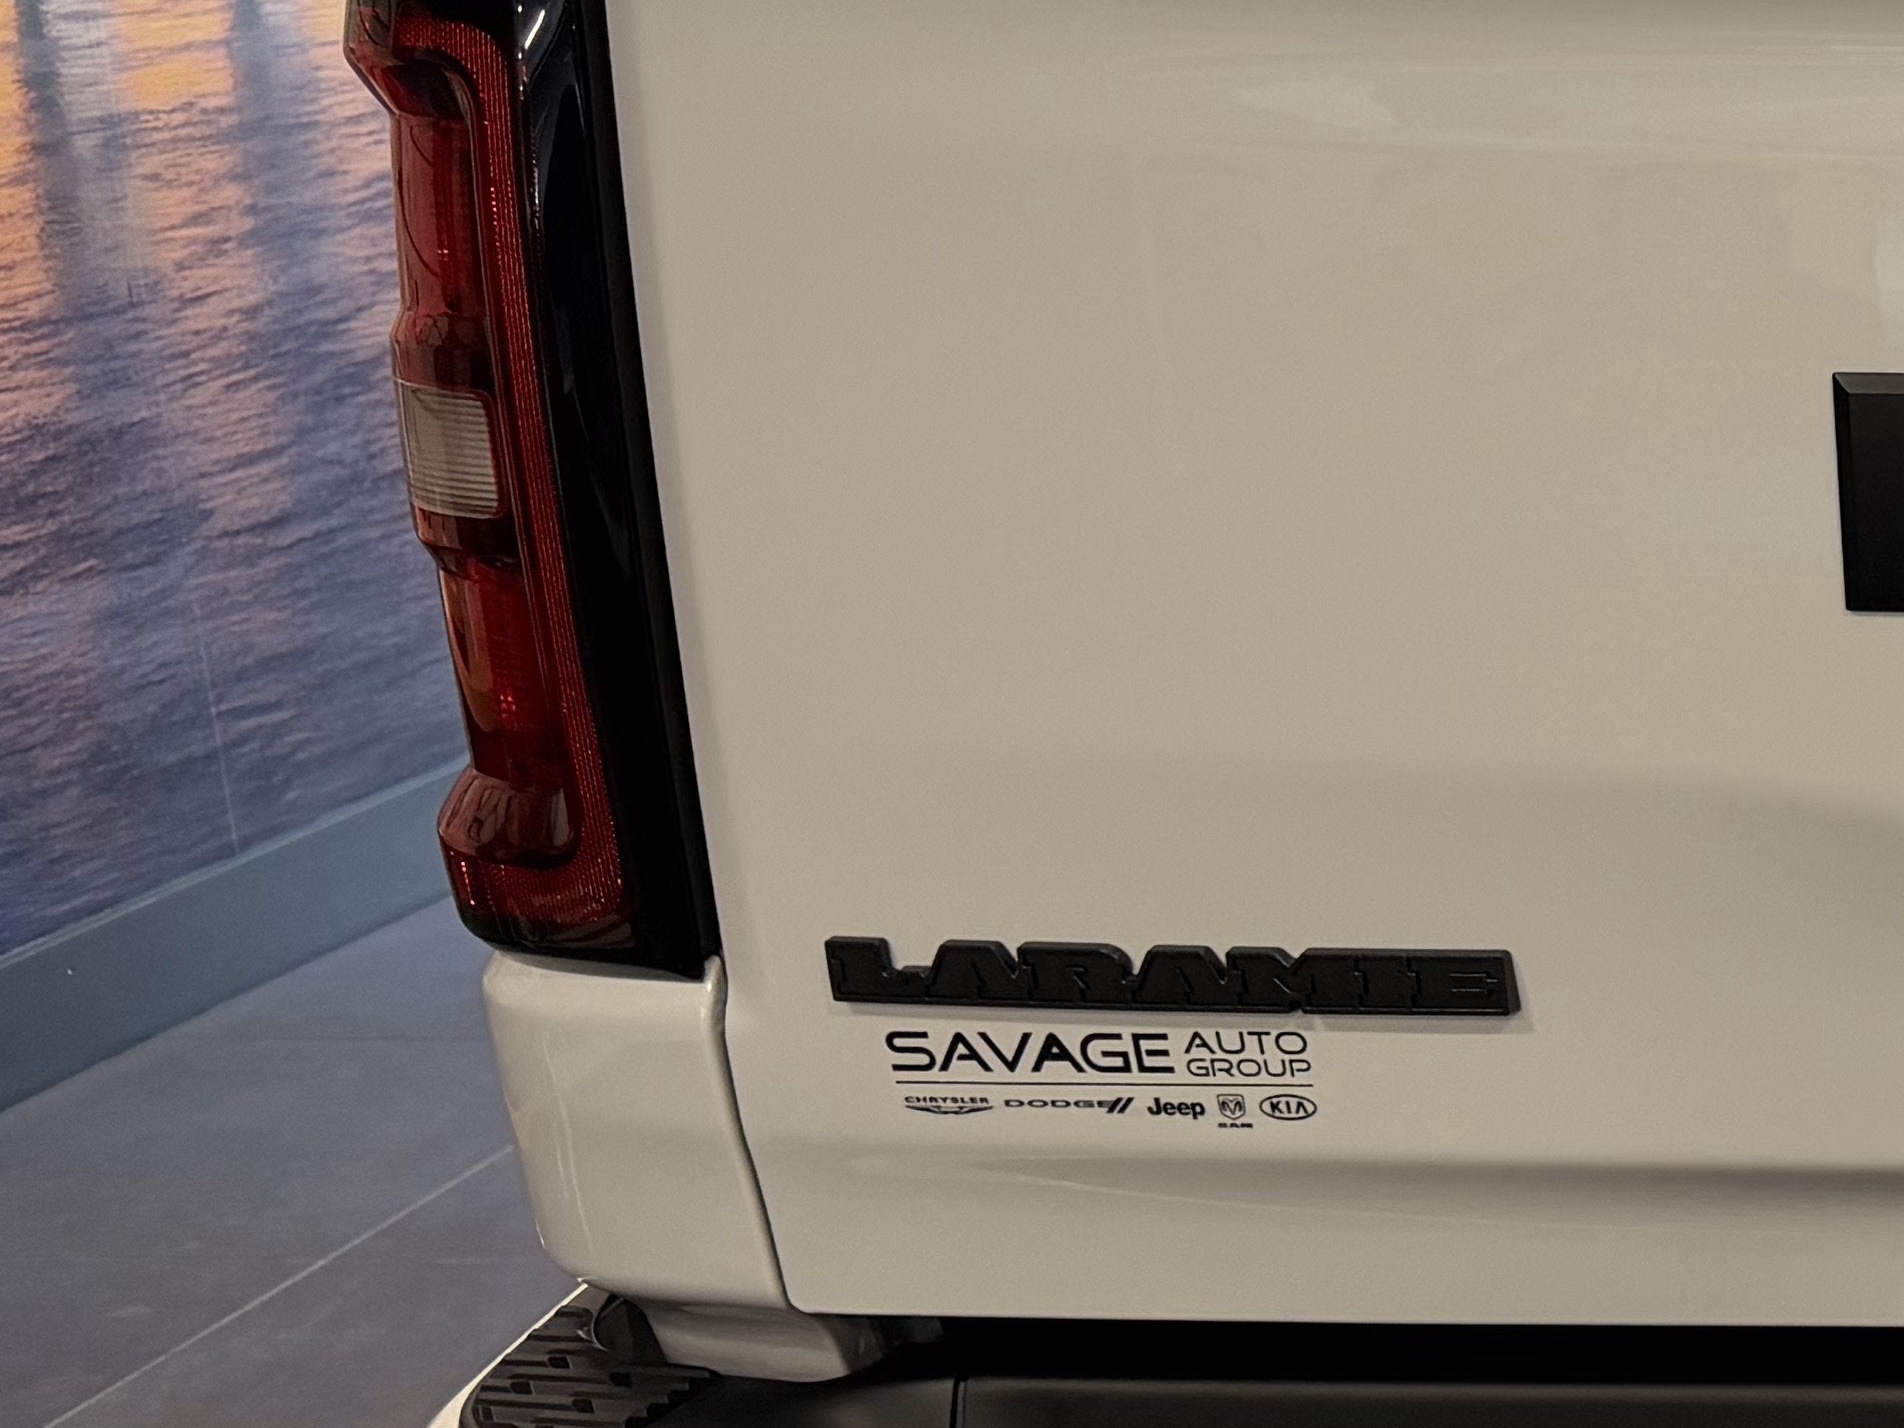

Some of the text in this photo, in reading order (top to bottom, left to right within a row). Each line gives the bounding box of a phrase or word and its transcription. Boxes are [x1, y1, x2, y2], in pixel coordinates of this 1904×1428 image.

[825, 936, 1521, 1016] LARAMIE
[886, 1030, 1308, 1074] SAVAGE AUTO
[1186, 1057, 1312, 1078] GROUP
[904, 1095, 1309, 1120] CHRYSLER DODGE Jeep KIA
